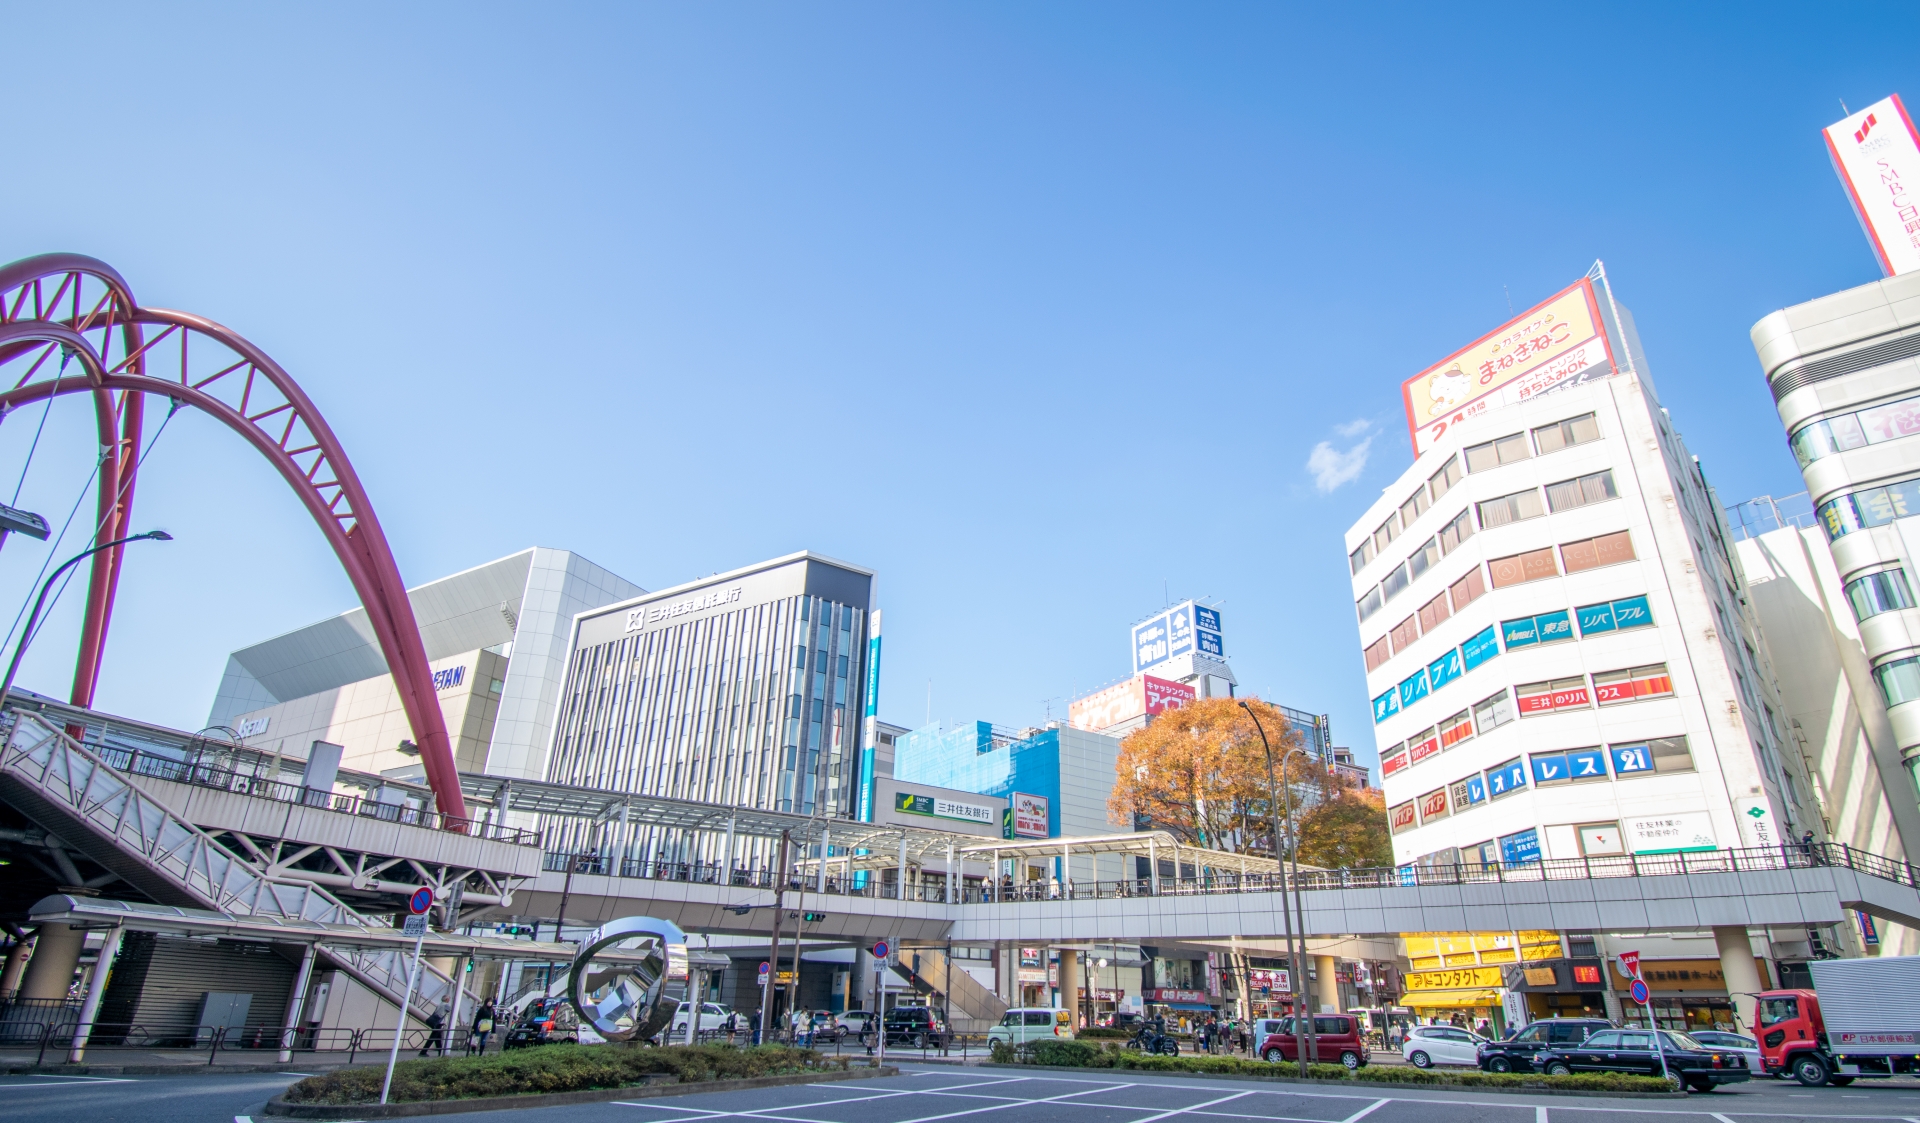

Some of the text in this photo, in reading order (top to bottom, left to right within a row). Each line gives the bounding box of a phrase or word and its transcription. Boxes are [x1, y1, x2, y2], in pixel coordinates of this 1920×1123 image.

[1502, 320, 1542, 347] カラオケ
[1480, 322, 1571, 385] まねきねこ
[1519, 357, 1588, 399] 持ち込みOK
[1526, 542, 1623, 569] AOBA CLINIC
[648, 587, 741, 623] 三井住友信託銀行
[1201, 616, 1215, 626] この先
[1139, 627, 1164, 645] 洋服の
[1172, 626, 1190, 640] この先
[1202, 632, 1217, 643] 洋服の
[1139, 640, 1166, 666] 青山
[1202, 640, 1218, 653] 青山
[1147, 681, 1194, 699] キャッシングなら
[1531, 687, 1620, 708] 三井のリハウス
[1396, 744, 1430, 768] 三井のリハウス
[938, 802, 990, 819] 三井住友銀行
[1424, 793, 1445, 818] TKP
[1395, 806, 1414, 828] TKP
[1636, 819, 1682, 830] 住友林業の
[1638, 828, 1680, 838] 不動産仲介
[1625, 956, 1637, 964] 止まれ
[1162, 990, 1175, 1000] OS
[1860, 1035, 1915, 1044] 日本郵便輸送
